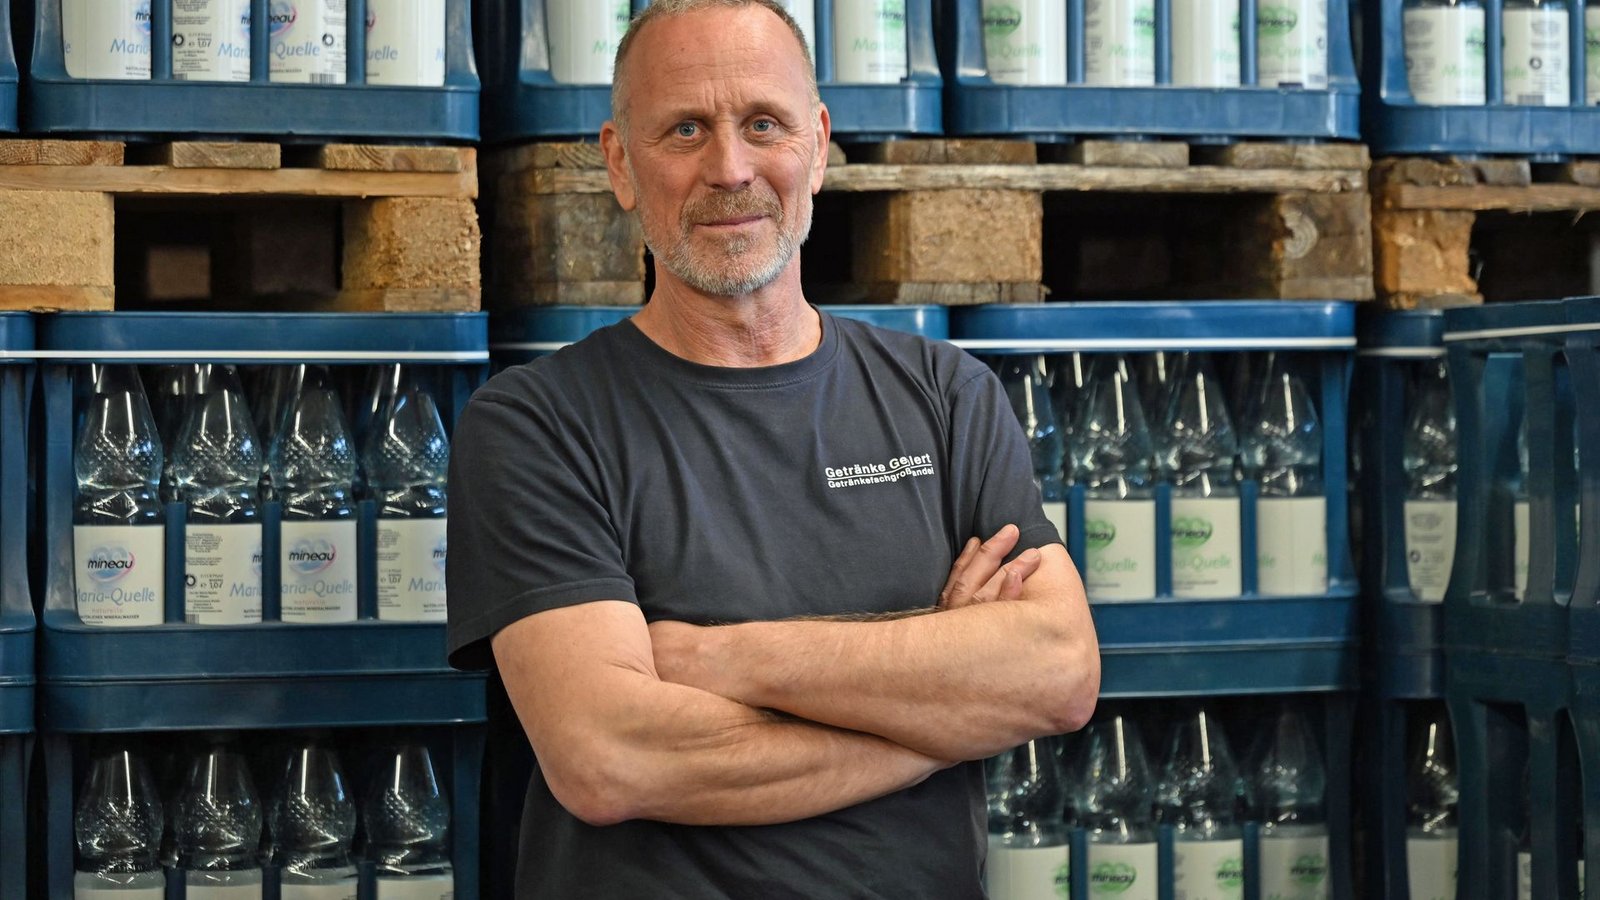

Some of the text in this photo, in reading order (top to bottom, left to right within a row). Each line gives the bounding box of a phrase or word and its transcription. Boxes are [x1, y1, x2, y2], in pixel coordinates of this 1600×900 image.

[367, 45, 398, 60] uelle
[825, 453, 932, 478] Getränke Gelert
[828, 467, 935, 489] Getränkefachgroßandel
[87, 557, 133, 569] mineau
[288, 549, 336, 561] mineau
[281, 580, 354, 598] aria-Quelle
